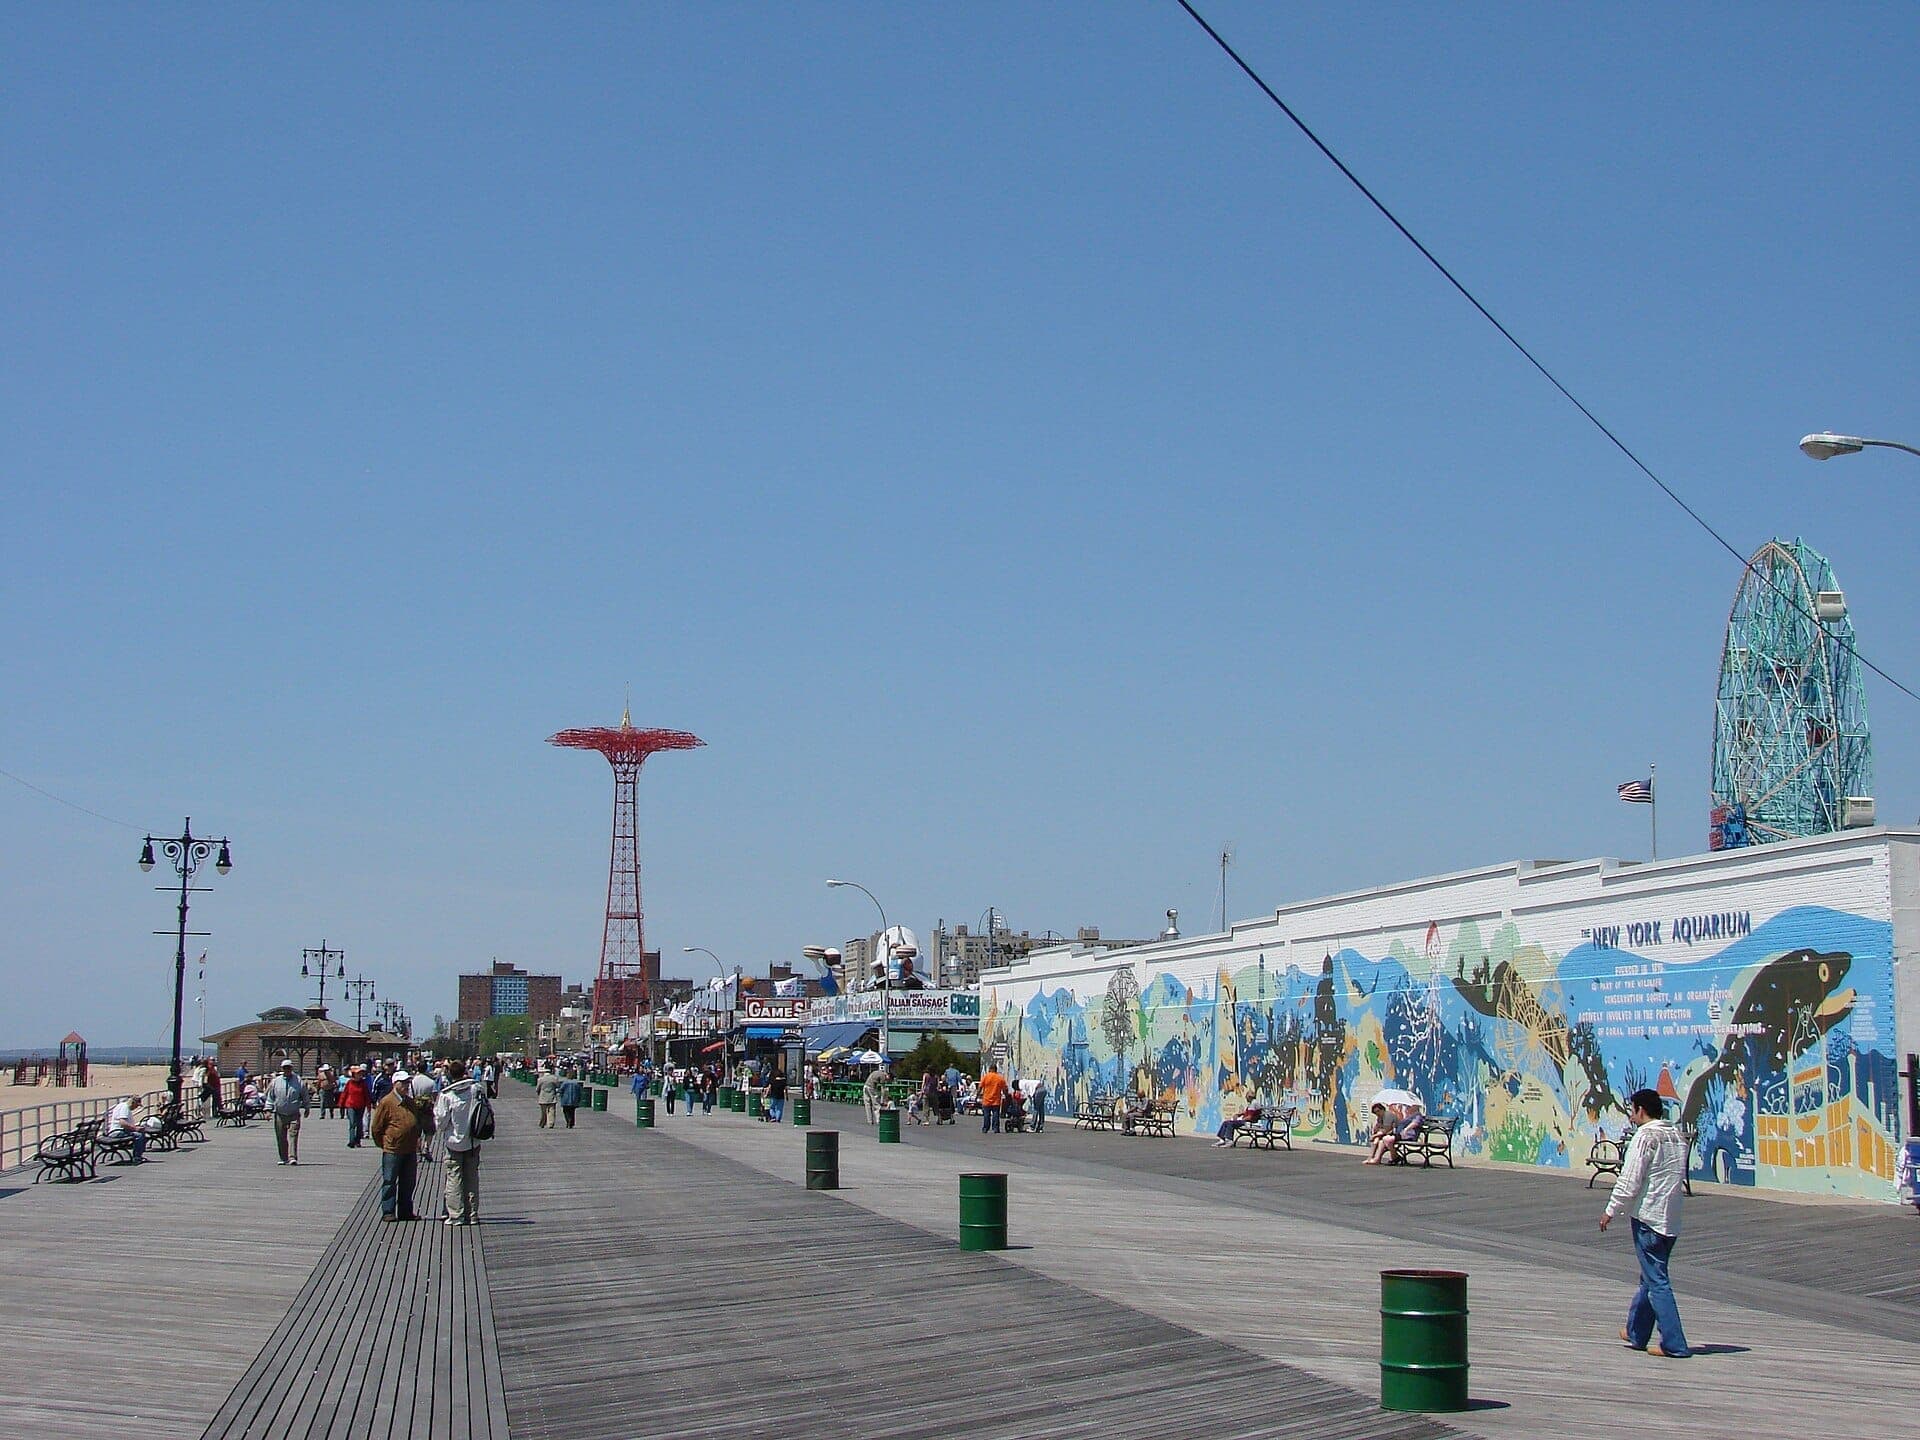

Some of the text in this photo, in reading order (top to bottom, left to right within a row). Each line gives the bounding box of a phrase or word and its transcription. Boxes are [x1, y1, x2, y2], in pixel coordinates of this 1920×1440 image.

[1592, 925, 1620, 951] NEW
[1626, 921, 1662, 948] YORK
[1672, 910, 1751, 947] AQUARIUM
[1624, 980, 1636, 989] THE
[911, 996, 948, 1008] SAUSAGE
[1673, 991, 1683, 1001] AN
[748, 1001, 804, 1018] GAMES
[1655, 1008, 1692, 1021] PROTECTION
